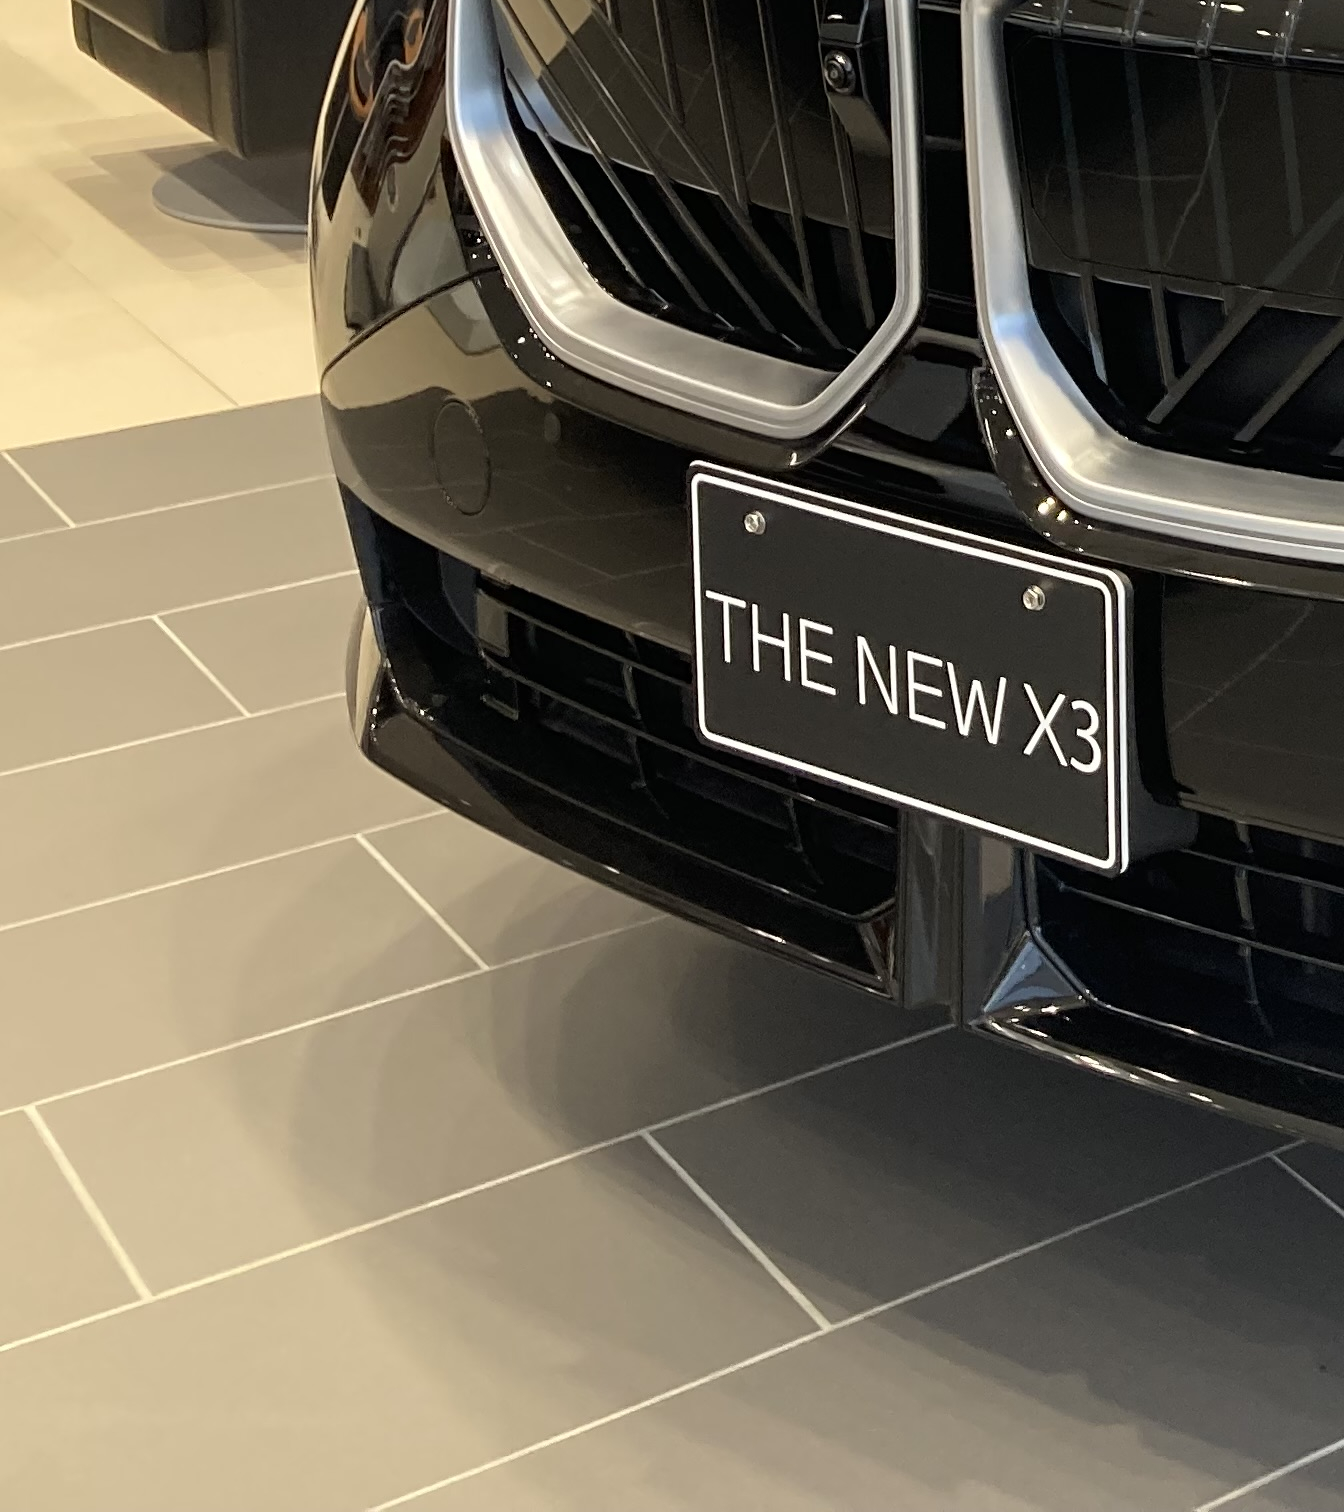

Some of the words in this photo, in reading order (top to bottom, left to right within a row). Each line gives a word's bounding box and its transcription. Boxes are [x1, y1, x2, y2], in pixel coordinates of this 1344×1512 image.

[706, 590, 837, 696] THE
[856, 636, 1007, 745] NEW
[1023, 682, 1102, 774] X3
